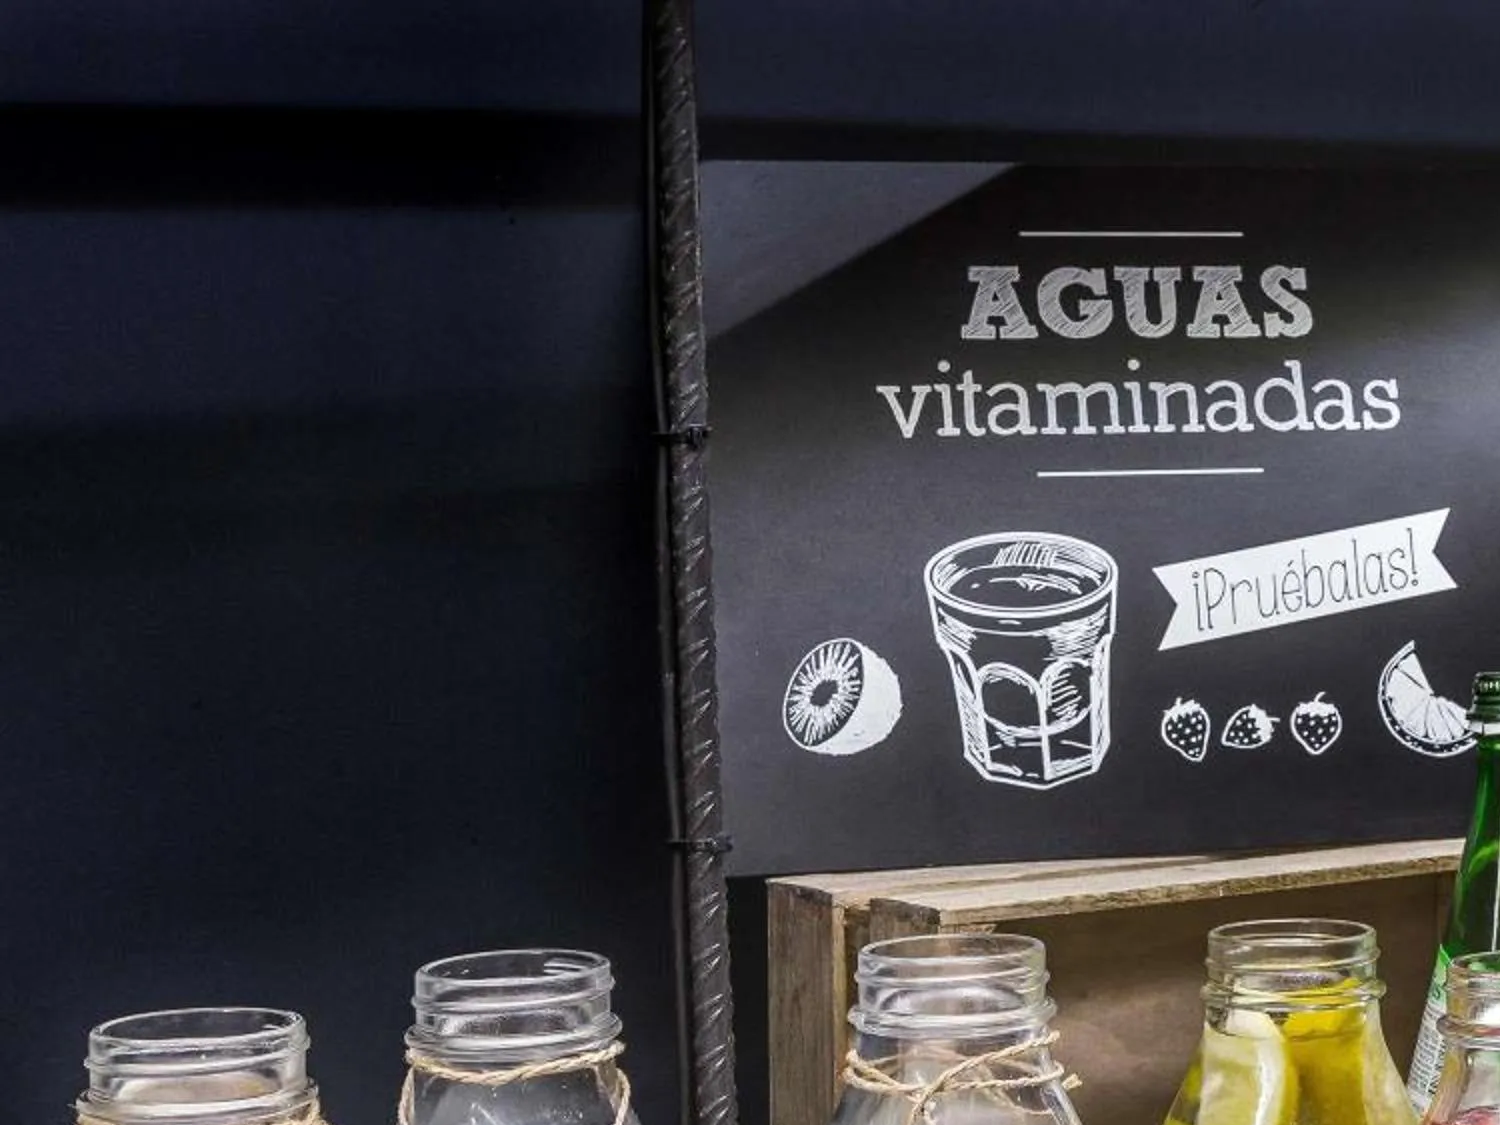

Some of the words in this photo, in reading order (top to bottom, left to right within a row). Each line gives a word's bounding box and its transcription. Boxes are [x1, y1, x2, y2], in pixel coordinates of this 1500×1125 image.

[961, 265, 1314, 339] AGUAS
[875, 360, 1401, 440] vitaminadas
[1191, 527, 1419, 632] ¡Pruébalas!
